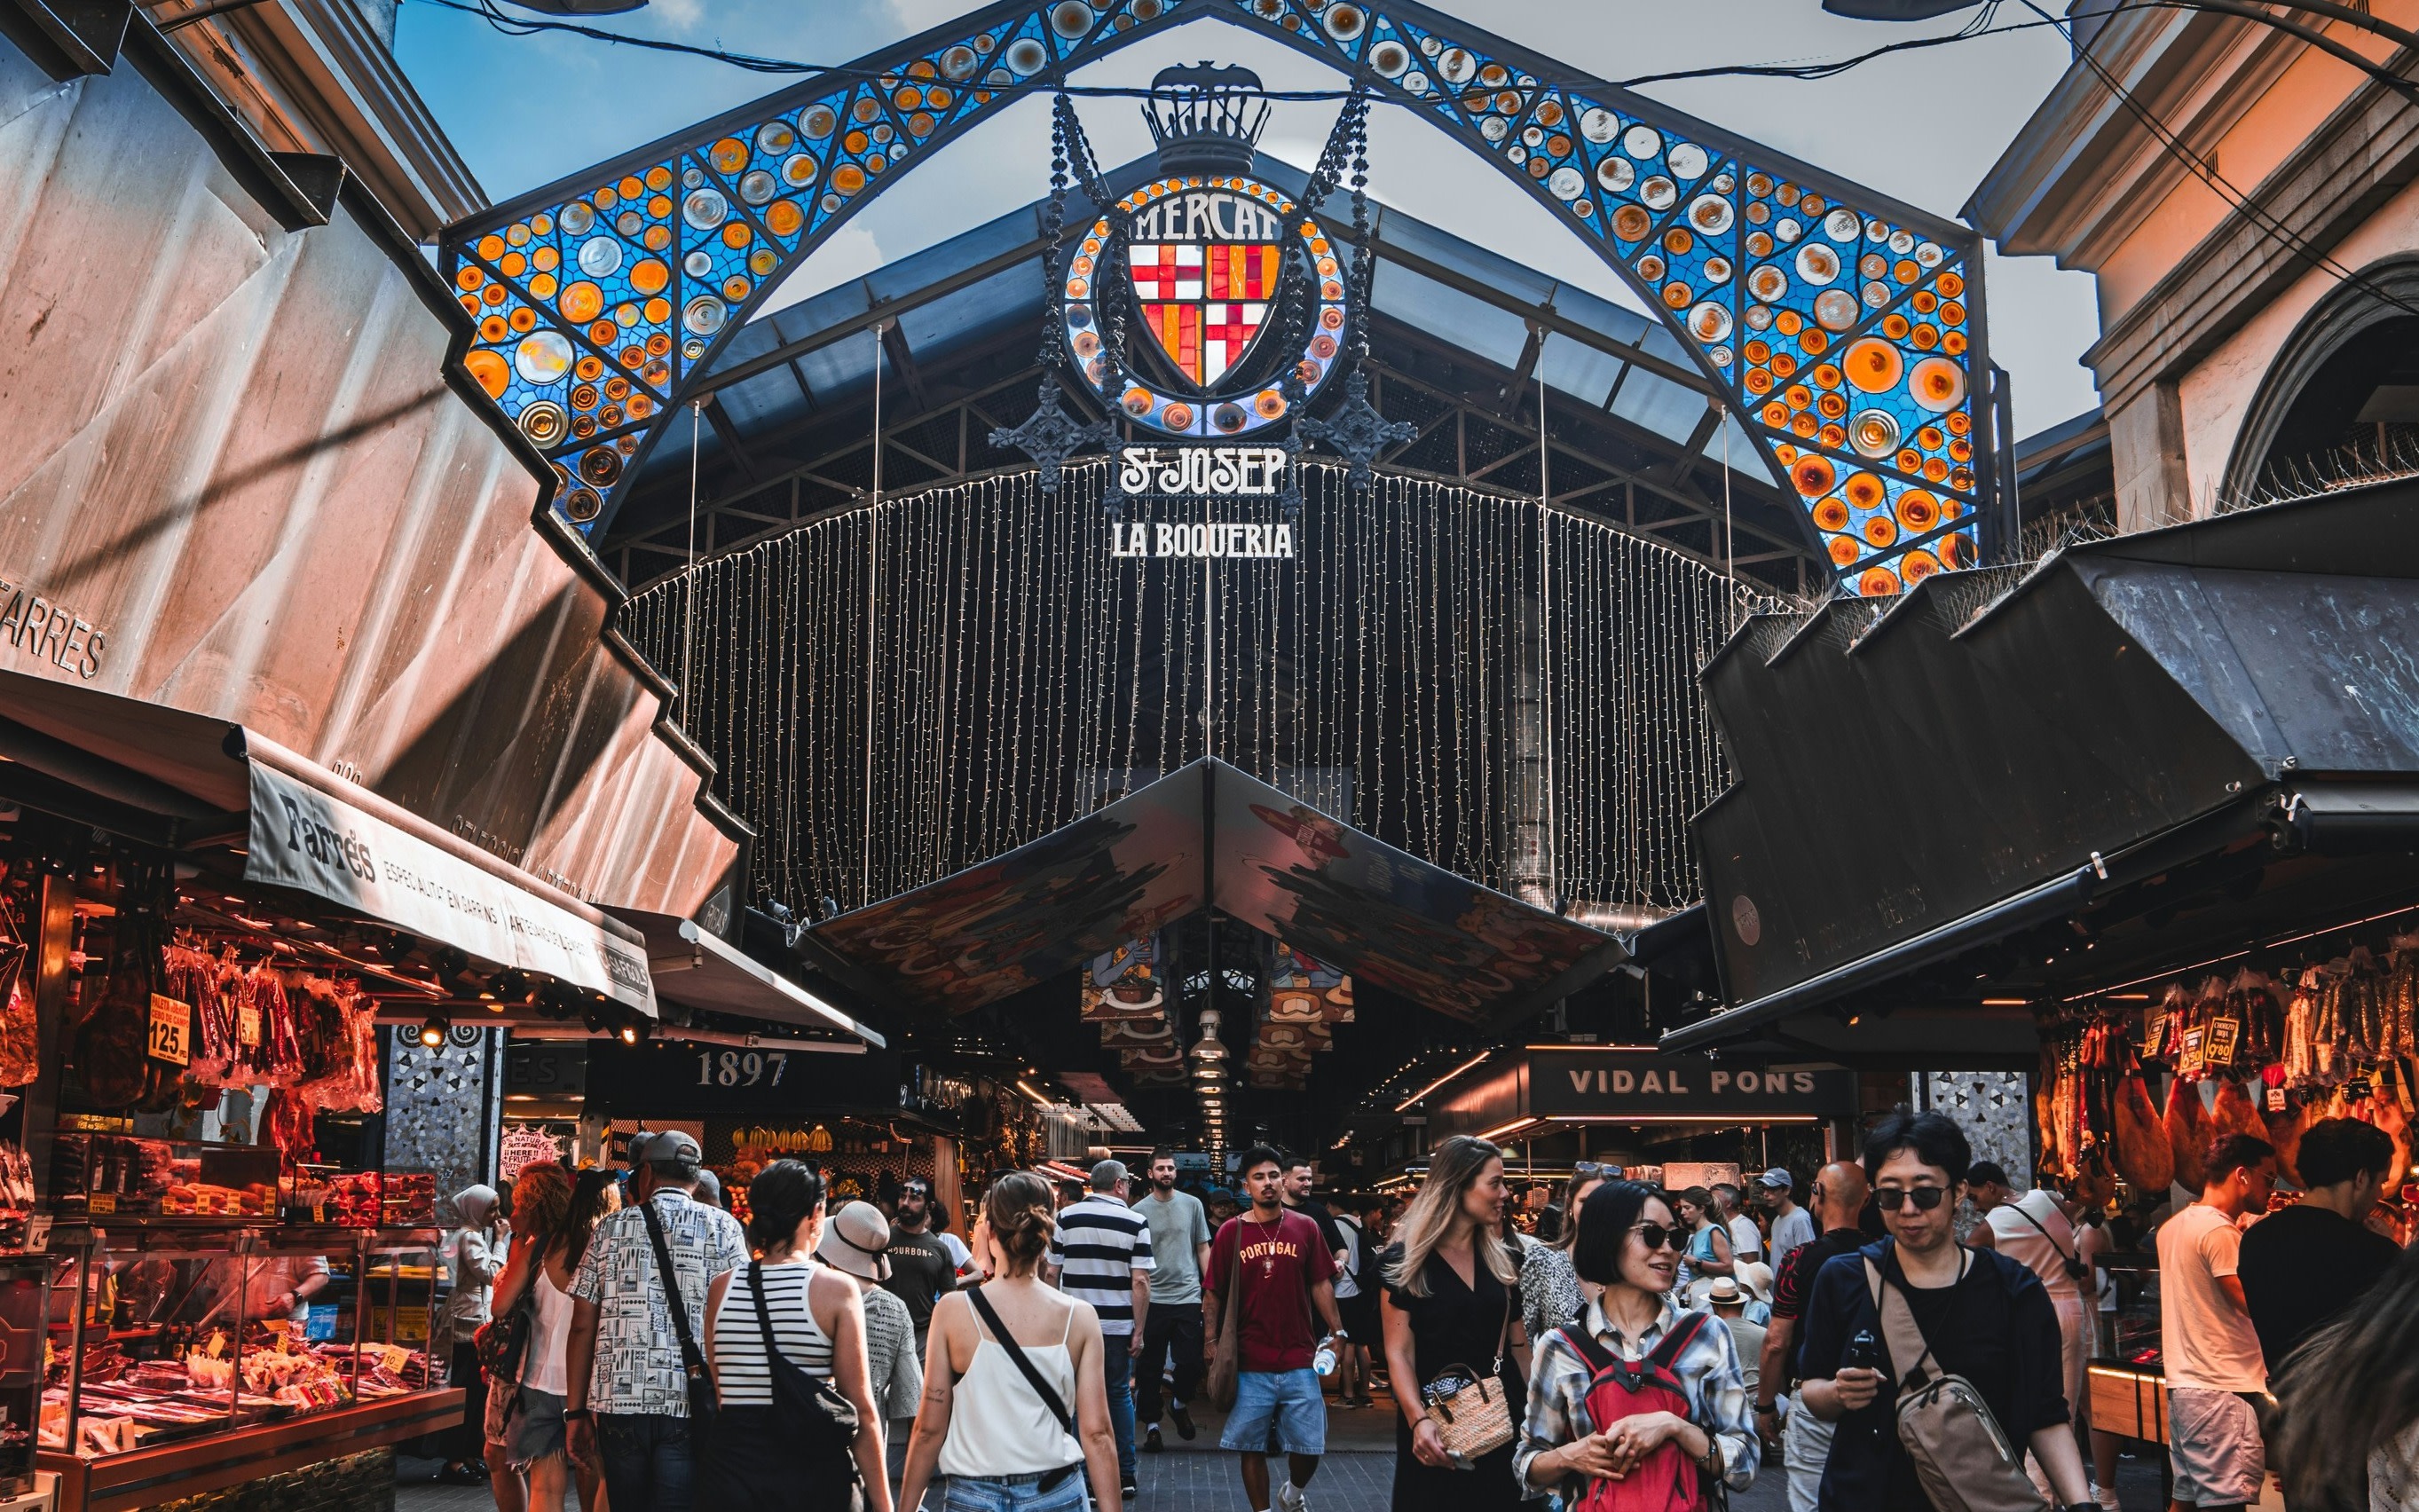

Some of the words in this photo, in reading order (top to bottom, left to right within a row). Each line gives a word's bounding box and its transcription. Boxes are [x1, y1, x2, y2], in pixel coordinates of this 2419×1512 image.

[1135, 193, 1278, 240] MERCAT
[1158, 447, 1287, 494] JOSEP
[1112, 523, 1148, 557] LA
[1155, 523, 1294, 558] BOQUERIA
[150, 1020, 179, 1055] 125
[697, 1051, 787, 1086] 1897
[1569, 1070, 1689, 1094] VIDAL
[1711, 1071, 1816, 1094] PONS
[1240, 1241, 1297, 1264] PORTUGAL
